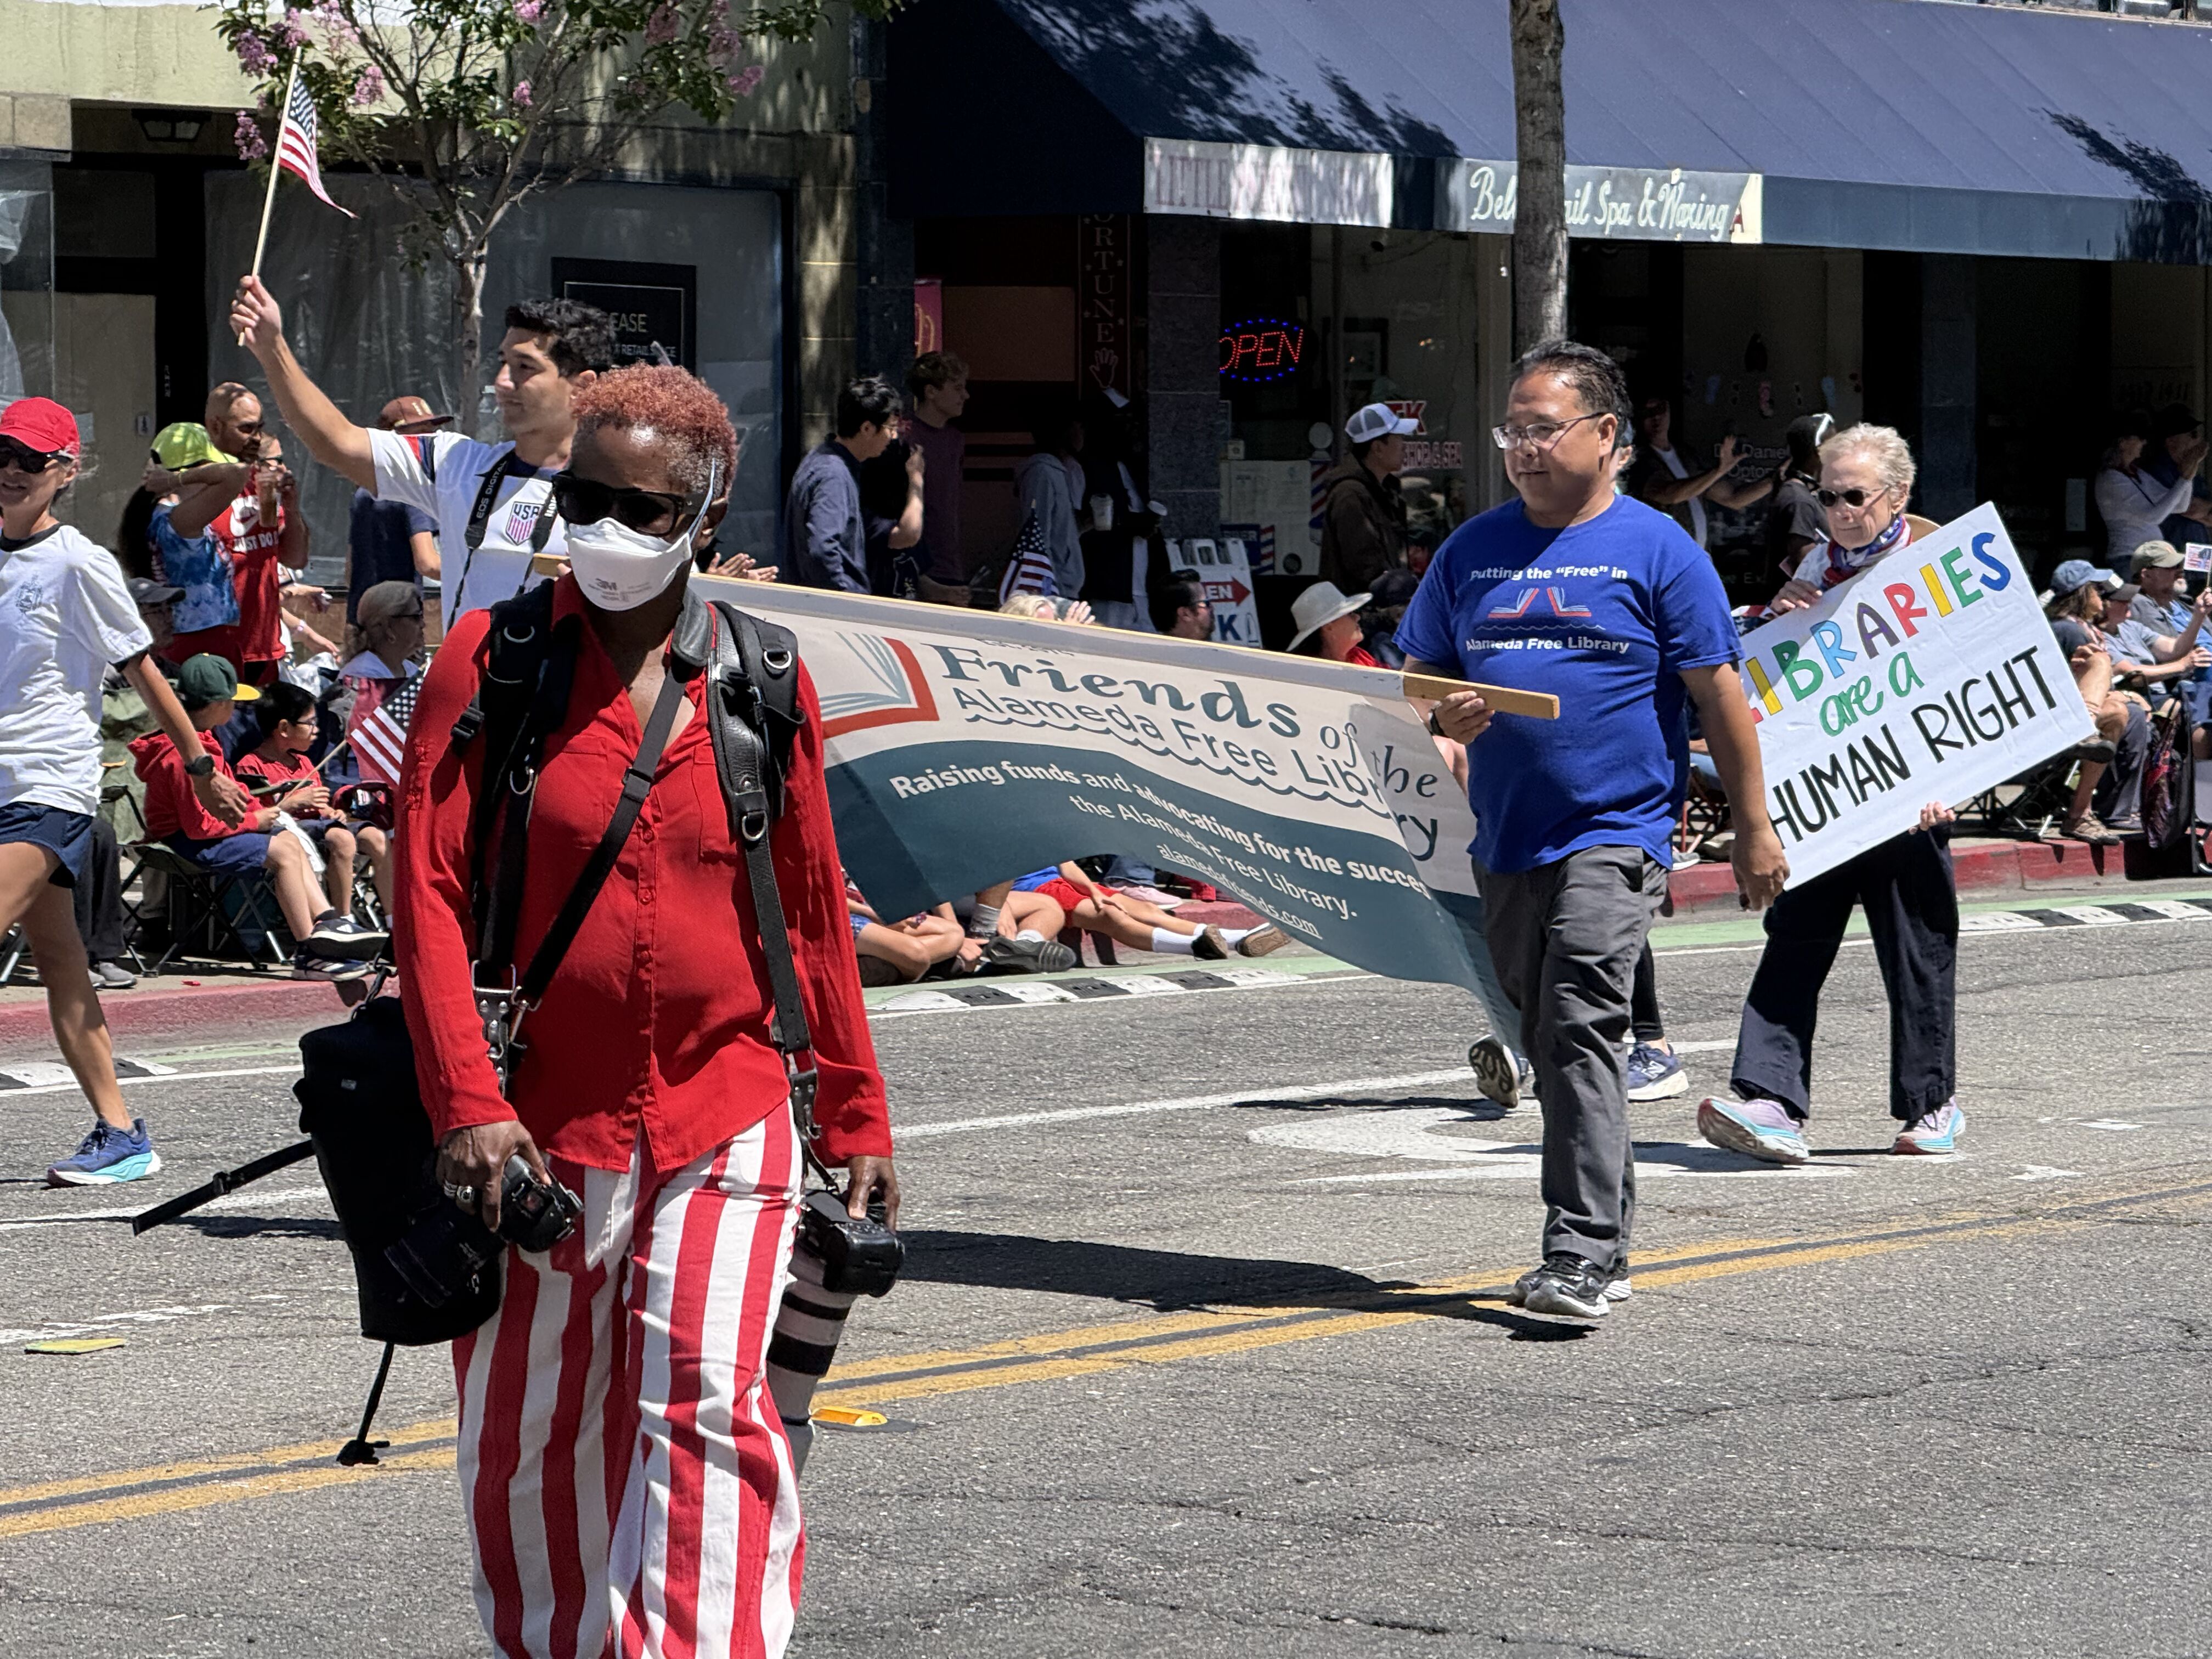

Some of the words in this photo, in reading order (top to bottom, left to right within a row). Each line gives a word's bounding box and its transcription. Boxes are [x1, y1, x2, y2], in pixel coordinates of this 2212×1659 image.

[1594, 179, 1633, 236] Spa
[1637, 177, 1657, 228] &
[1657, 182, 1730, 241] Waxing
[610, 312, 648, 333] EASE
[1219, 328, 1305, 371] OPEN
[476, 498, 489, 519] EOS
[485, 460, 507, 495] DIGITAL
[258, 531, 273, 548] DO
[595, 578, 617, 591] 3M
[1526, 567, 1553, 580] the
[1611, 567, 1628, 579] in
[1465, 637, 1523, 651] Alameda
[1526, 637, 1564, 650] Free
[1567, 636, 1630, 654] Library
[1745, 532, 2012, 726] IBRARIES
[919, 642, 1301, 738] Friends
[1320, 721, 1357, 768] of
[1369, 744, 1438, 798] the
[1819, 675, 1884, 737] are
[1888, 651, 1925, 698] a
[952, 686, 1166, 742] Alameda
[1171, 718, 1278, 776] Free
[1769, 723, 1911, 850] HUMAN
[1911, 645, 2057, 764] RIGHT
[889, 764, 1006, 799] Raising
[1001, 760, 1081, 785] funds
[1081, 772, 1133, 794] and
[1135, 782, 1255, 855] advocating
[1252, 832, 1291, 864] for
[1294, 845, 1344, 876] the
[1069, 794, 1116, 819] the
[1117, 803, 1214, 859] Alameda
[1209, 844, 1263, 883] Free
[1261, 866, 1358, 921] Library.
